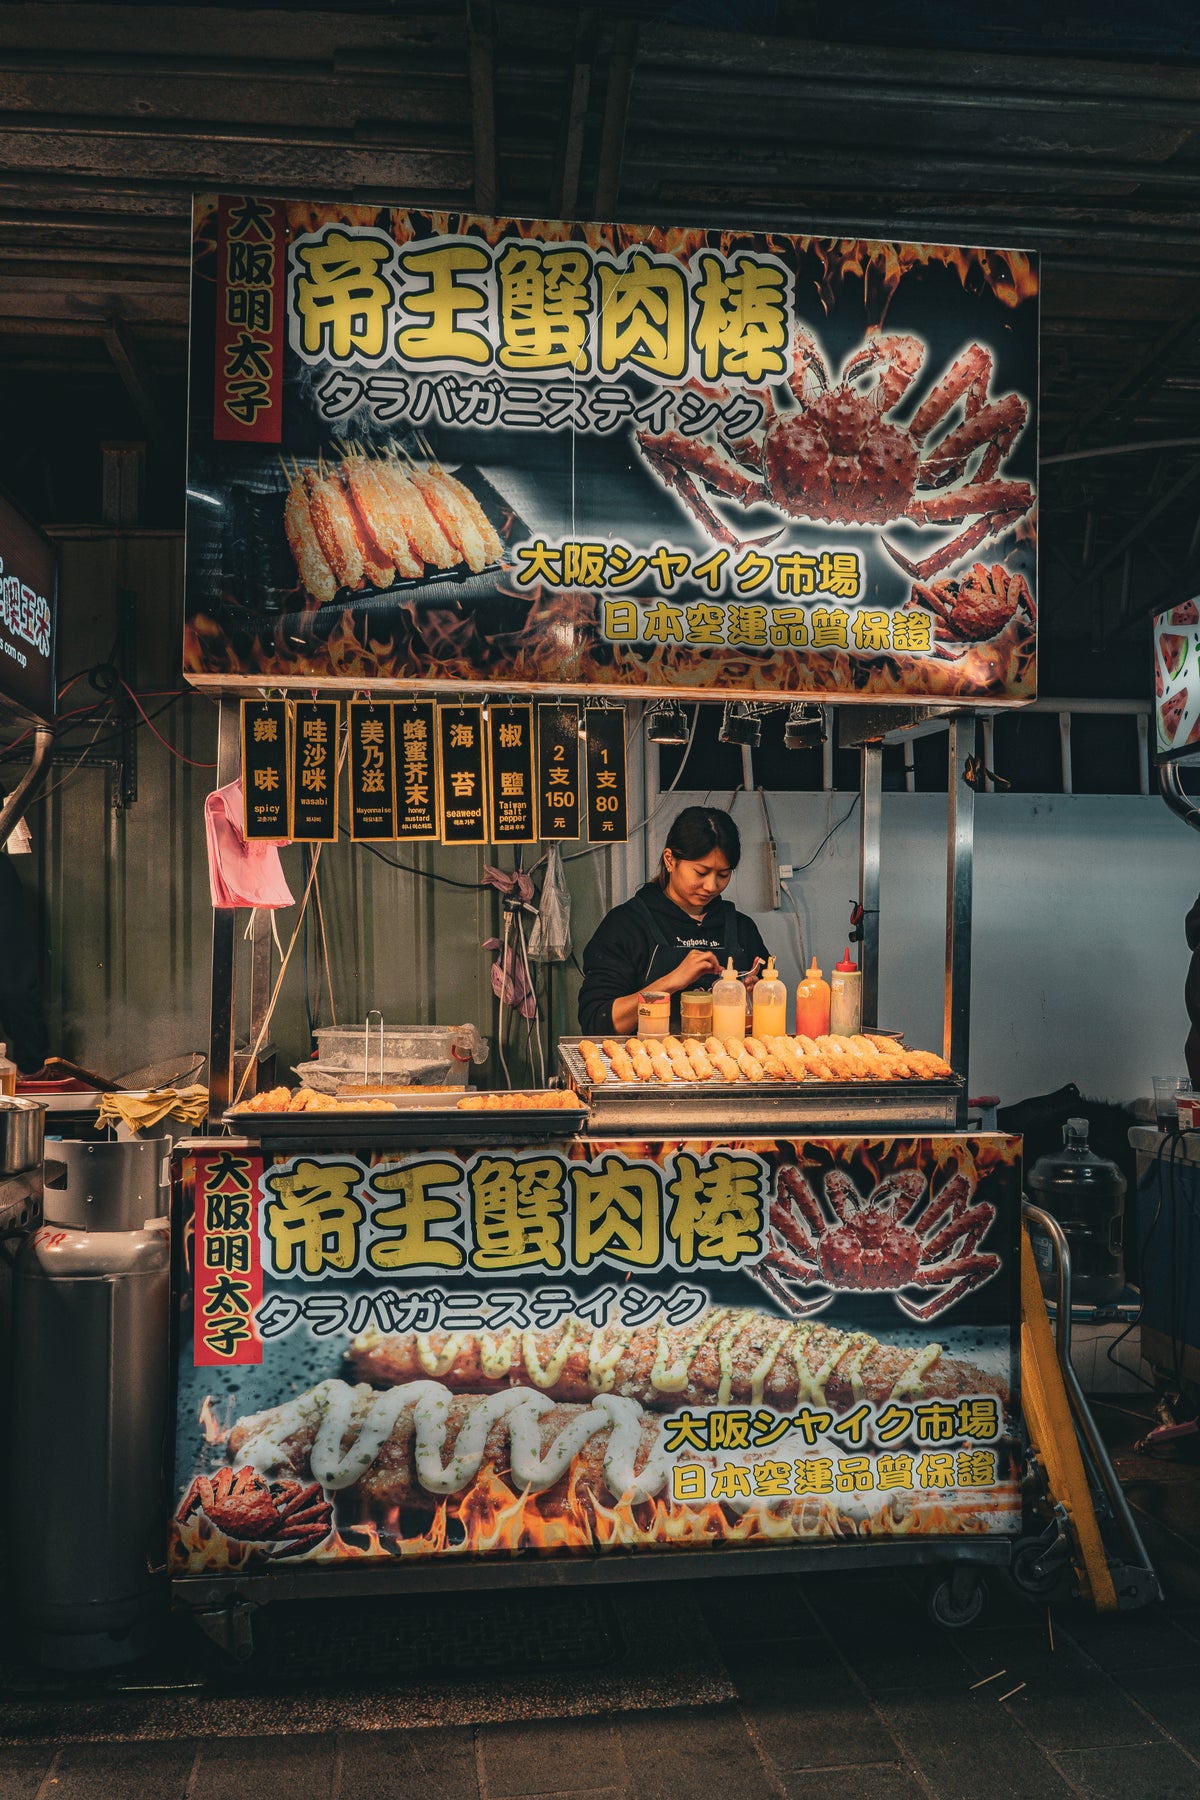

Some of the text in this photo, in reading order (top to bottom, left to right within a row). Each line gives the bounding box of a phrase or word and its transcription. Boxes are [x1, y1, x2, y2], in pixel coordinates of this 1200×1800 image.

[225, 198, 276, 427] 大阪明太子
[297, 229, 788, 383] 帝王蟹肉棒
[602, 600, 931, 653] 日本空運品質保證
[302, 718, 328, 793] 哇沙咪
[360, 719, 386, 793] 美乃滋
[403, 718, 430, 806] 蜂蜜芥末
[254, 804, 280, 815] spicy
[300, 796, 328, 806] wasabi
[356, 806, 392, 815] Mayonnaise
[408, 806, 426, 815] honey
[446, 808, 482, 818] seaweed
[499, 801, 527, 809] Taiwan
[503, 808, 522, 816] salt
[405, 814, 430, 822] mustard
[499, 815, 527, 824] pepper
[264, 1152, 763, 1275] 帝王蟹肉棒
[204, 1150, 254, 1357] 大阪明太子
[672, 1451, 997, 1500] 日本空運品質保證
